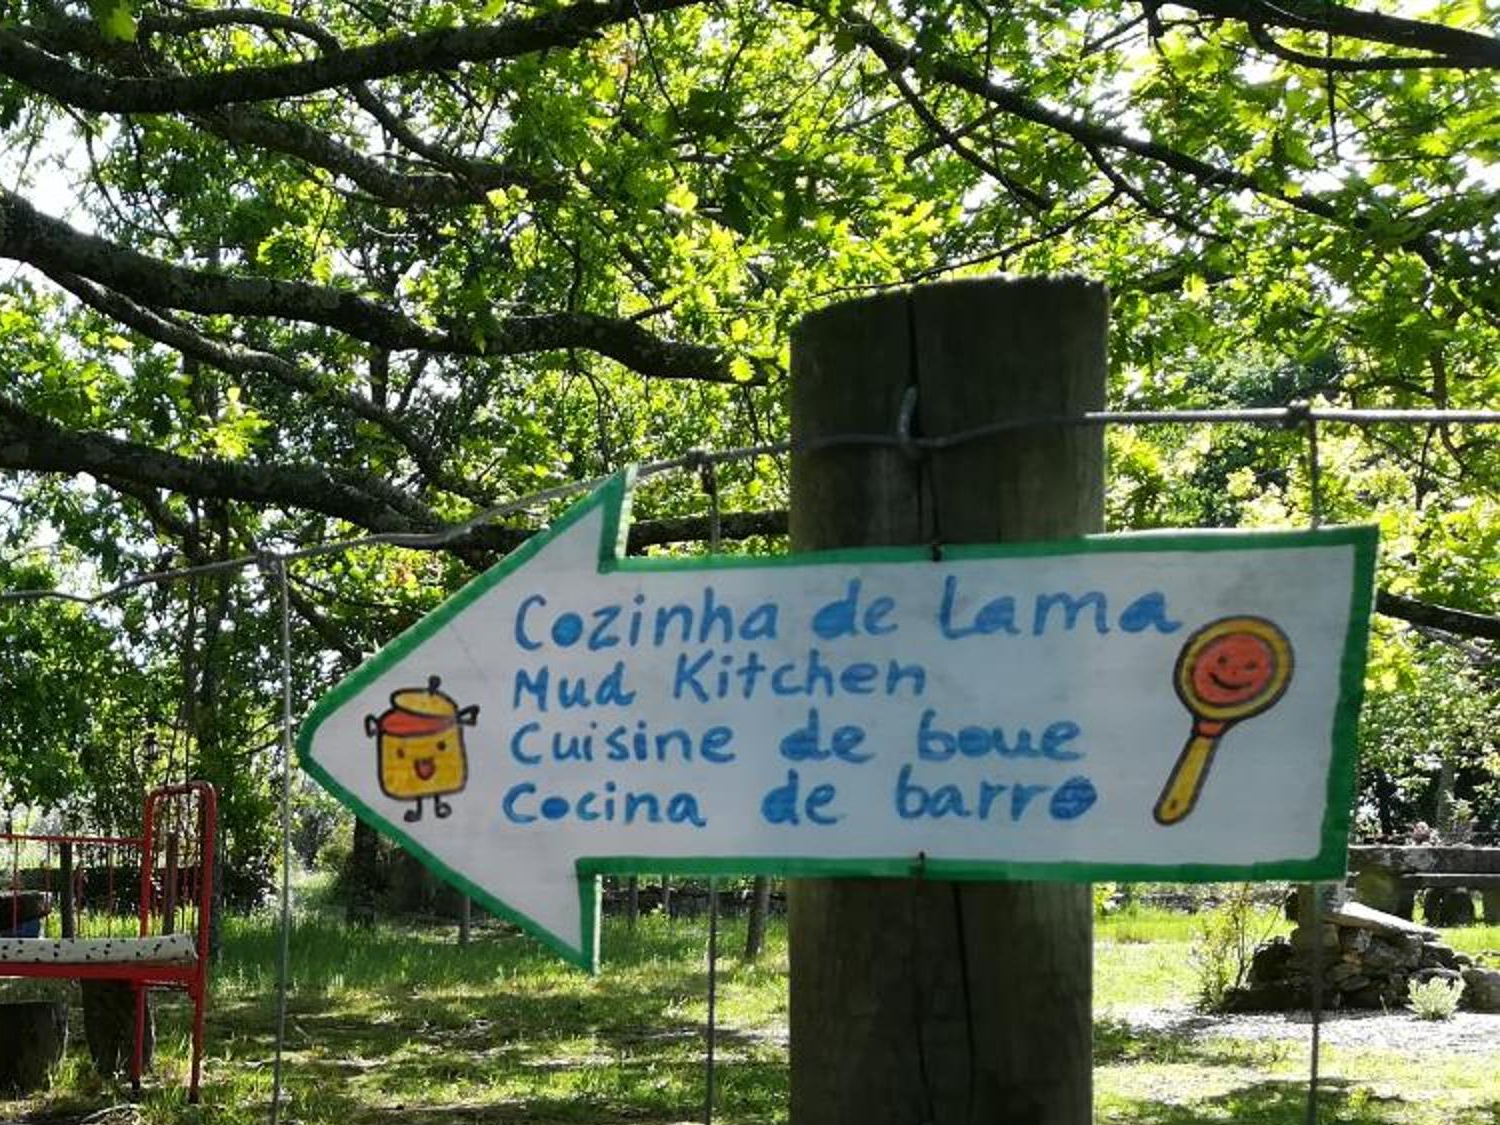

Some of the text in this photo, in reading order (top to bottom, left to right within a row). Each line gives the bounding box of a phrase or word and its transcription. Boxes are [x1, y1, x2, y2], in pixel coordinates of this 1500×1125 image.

[514, 586, 779, 651] Cozinha
[810, 578, 899, 641] de
[513, 648, 927, 712] Mud Kitchen
[510, 706, 1085, 765] Cuisine de boue
[761, 767, 844, 826] de
[894, 763, 1098, 823] barro
